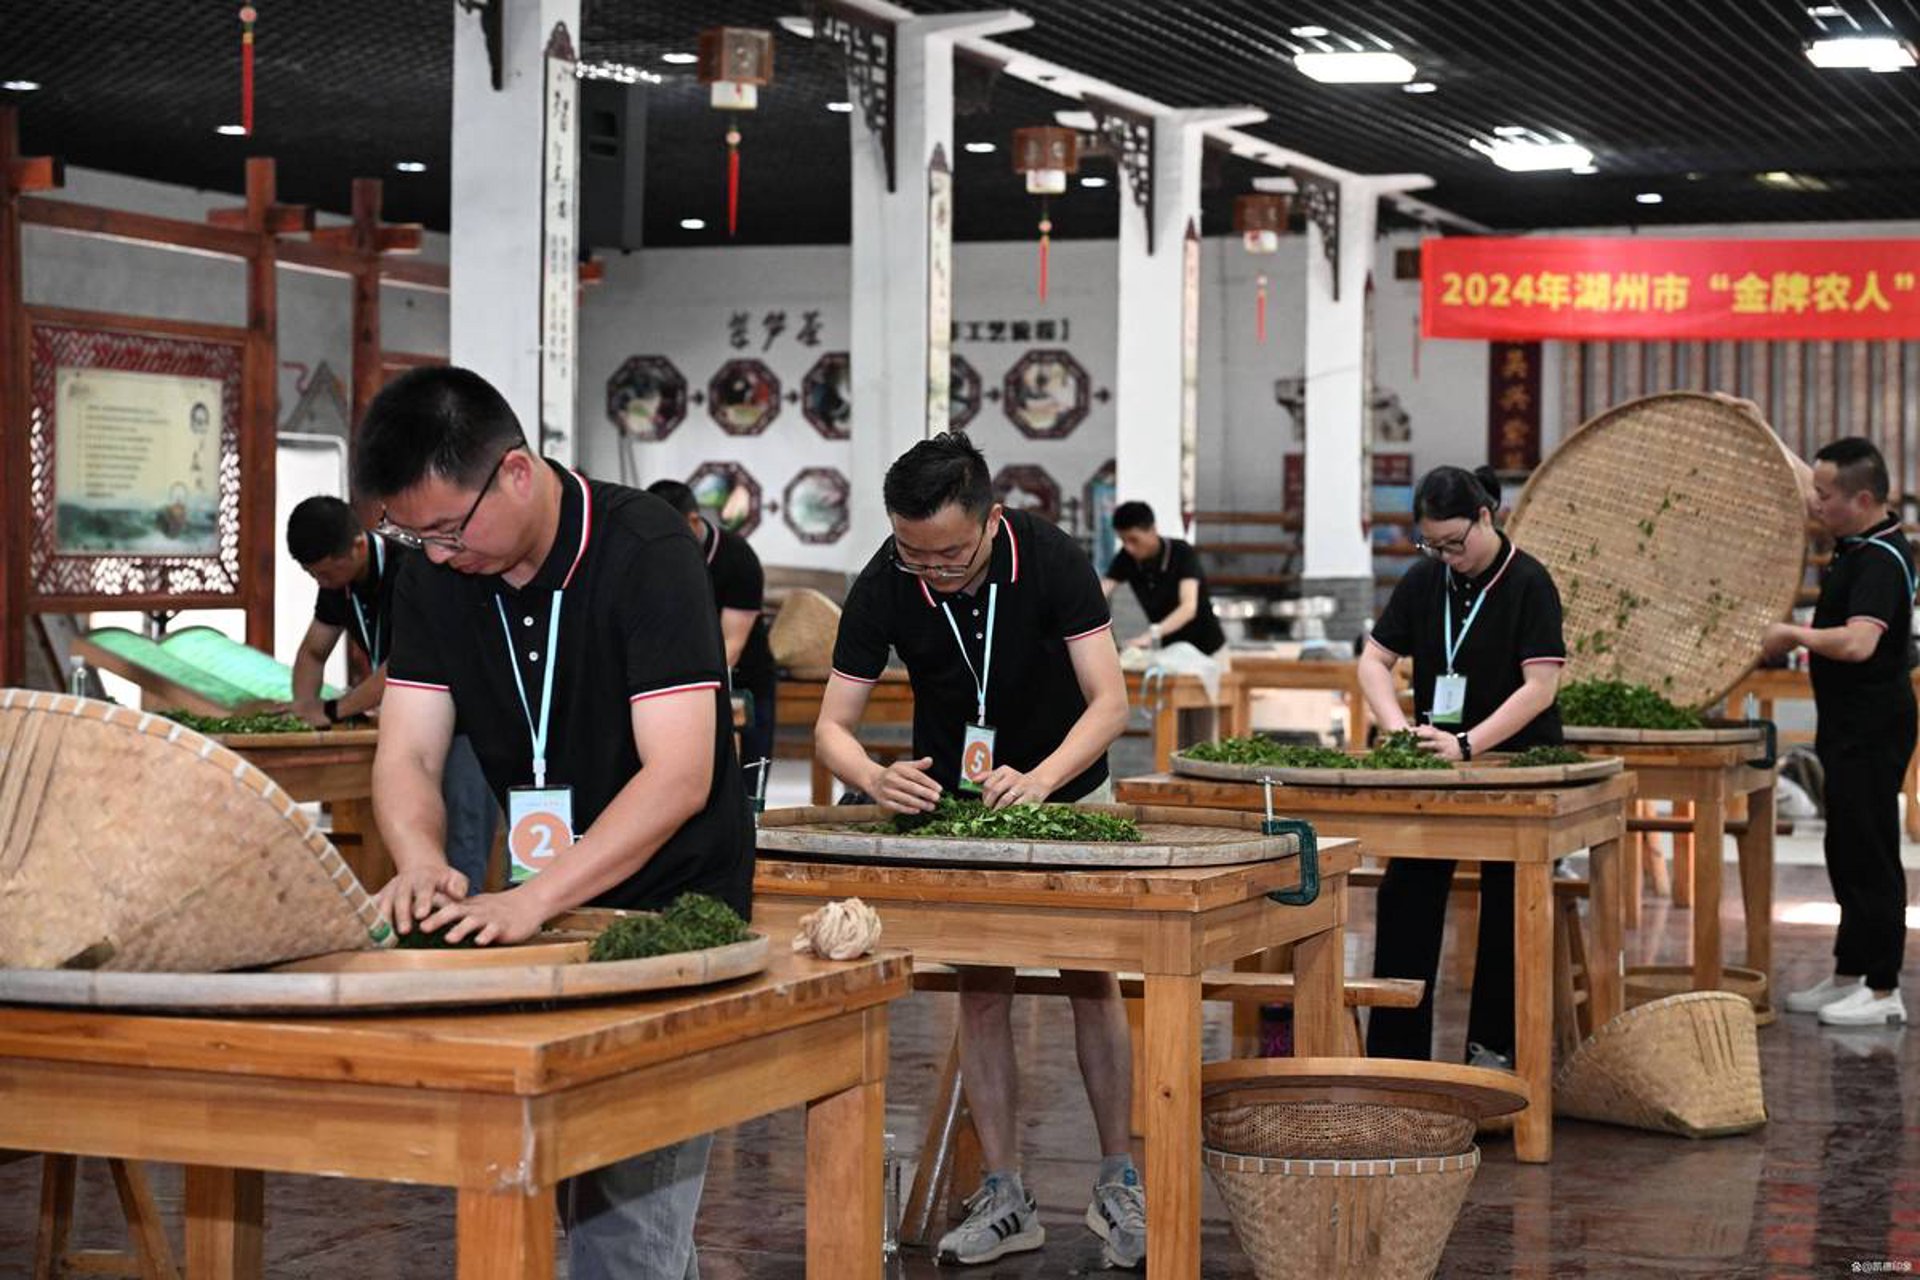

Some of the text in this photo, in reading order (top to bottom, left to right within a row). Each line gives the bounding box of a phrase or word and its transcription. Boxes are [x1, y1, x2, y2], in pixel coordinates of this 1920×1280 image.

[1442, 271, 1915, 313] 2024年湖州市“金牌农人”
[971, 749, 985, 774] 5
[529, 823, 555, 858] 2
